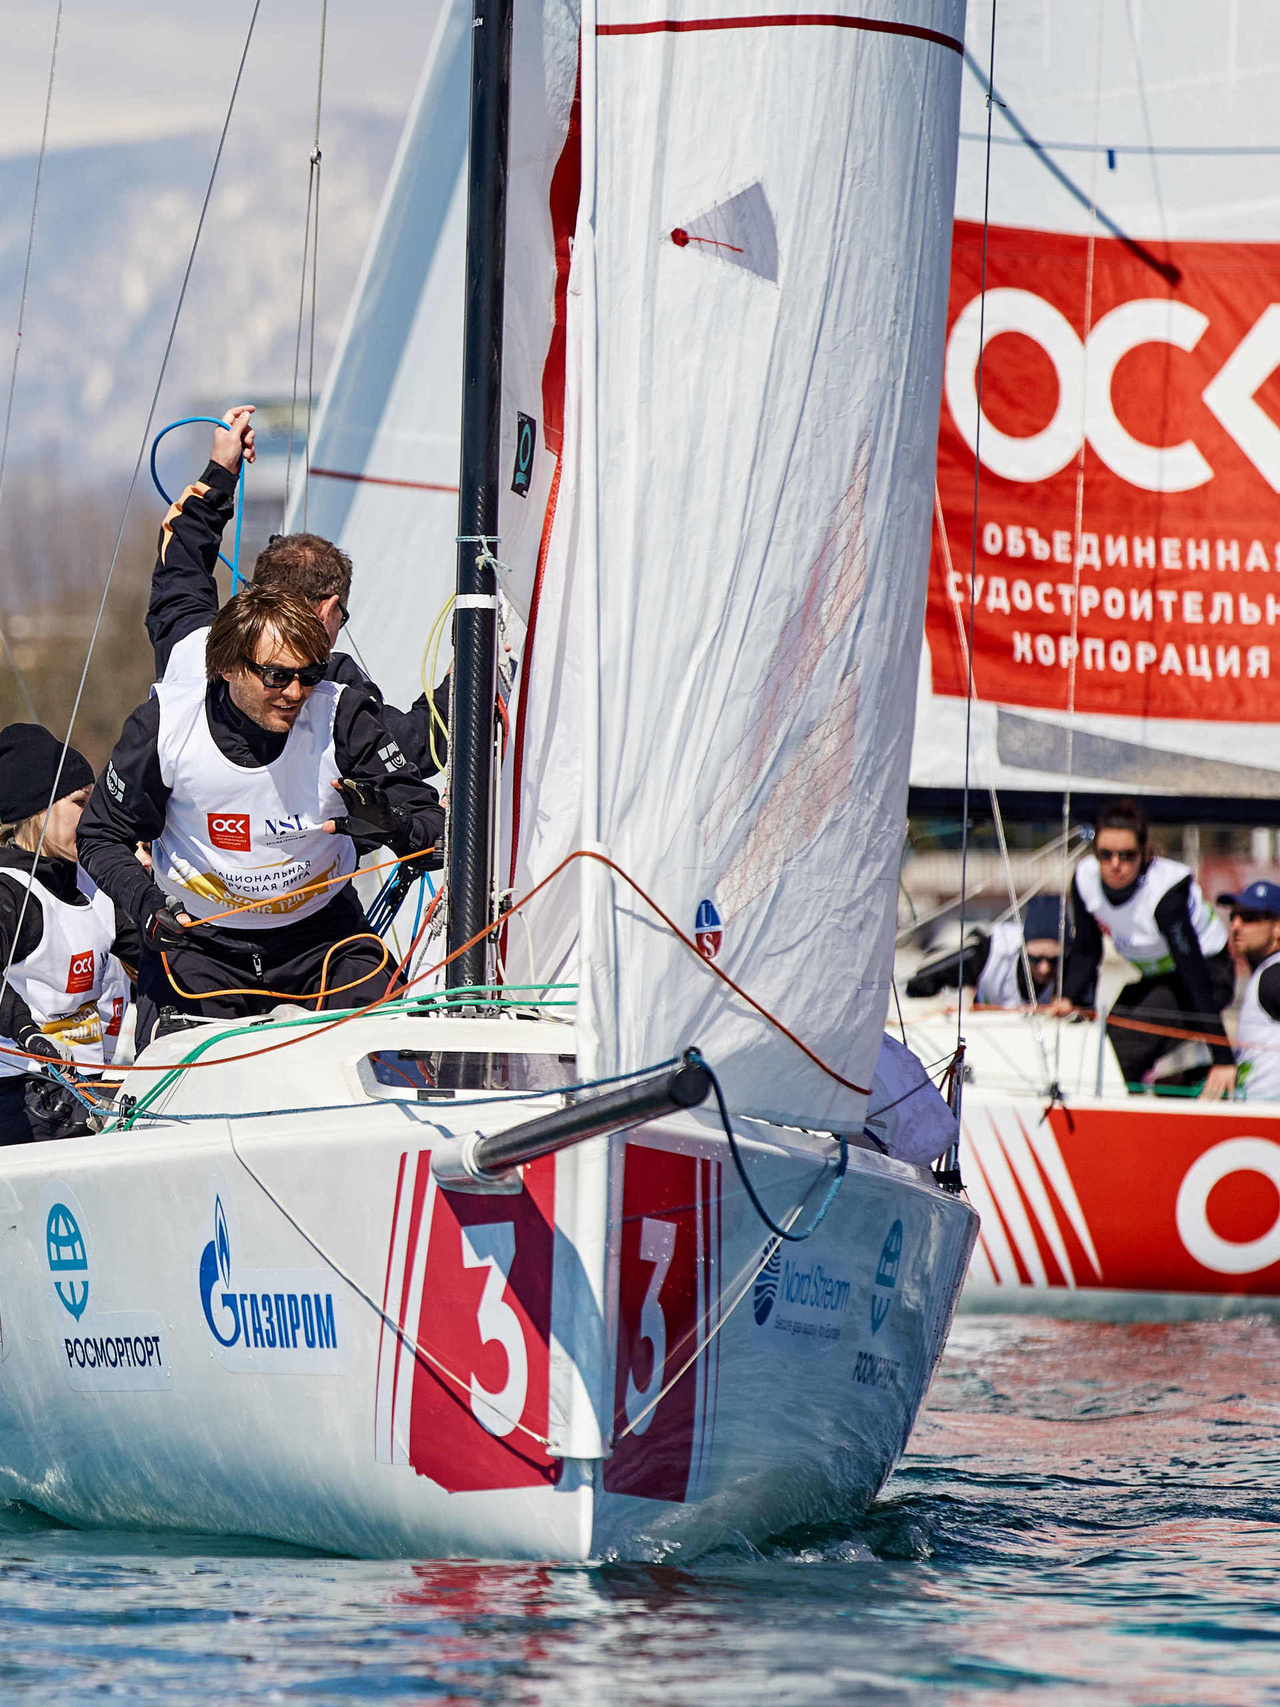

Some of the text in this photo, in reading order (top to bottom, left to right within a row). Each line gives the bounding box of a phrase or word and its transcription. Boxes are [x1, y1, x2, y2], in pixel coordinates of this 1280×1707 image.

[983, 522, 1280, 573] ОБЪЕДИНЕННА
[1013, 631, 1270, 682] КОРПОРАЦИЯ
[212, 819, 245, 834] ОСК
[282, 870, 311, 888] ЛИГА
[240, 1292, 339, 1350] ГАЗПРОМ
[461, 1221, 528, 1438] 3
[626, 1217, 678, 1436] 3
[65, 1335, 164, 1369] РОСМОРПОРТ
